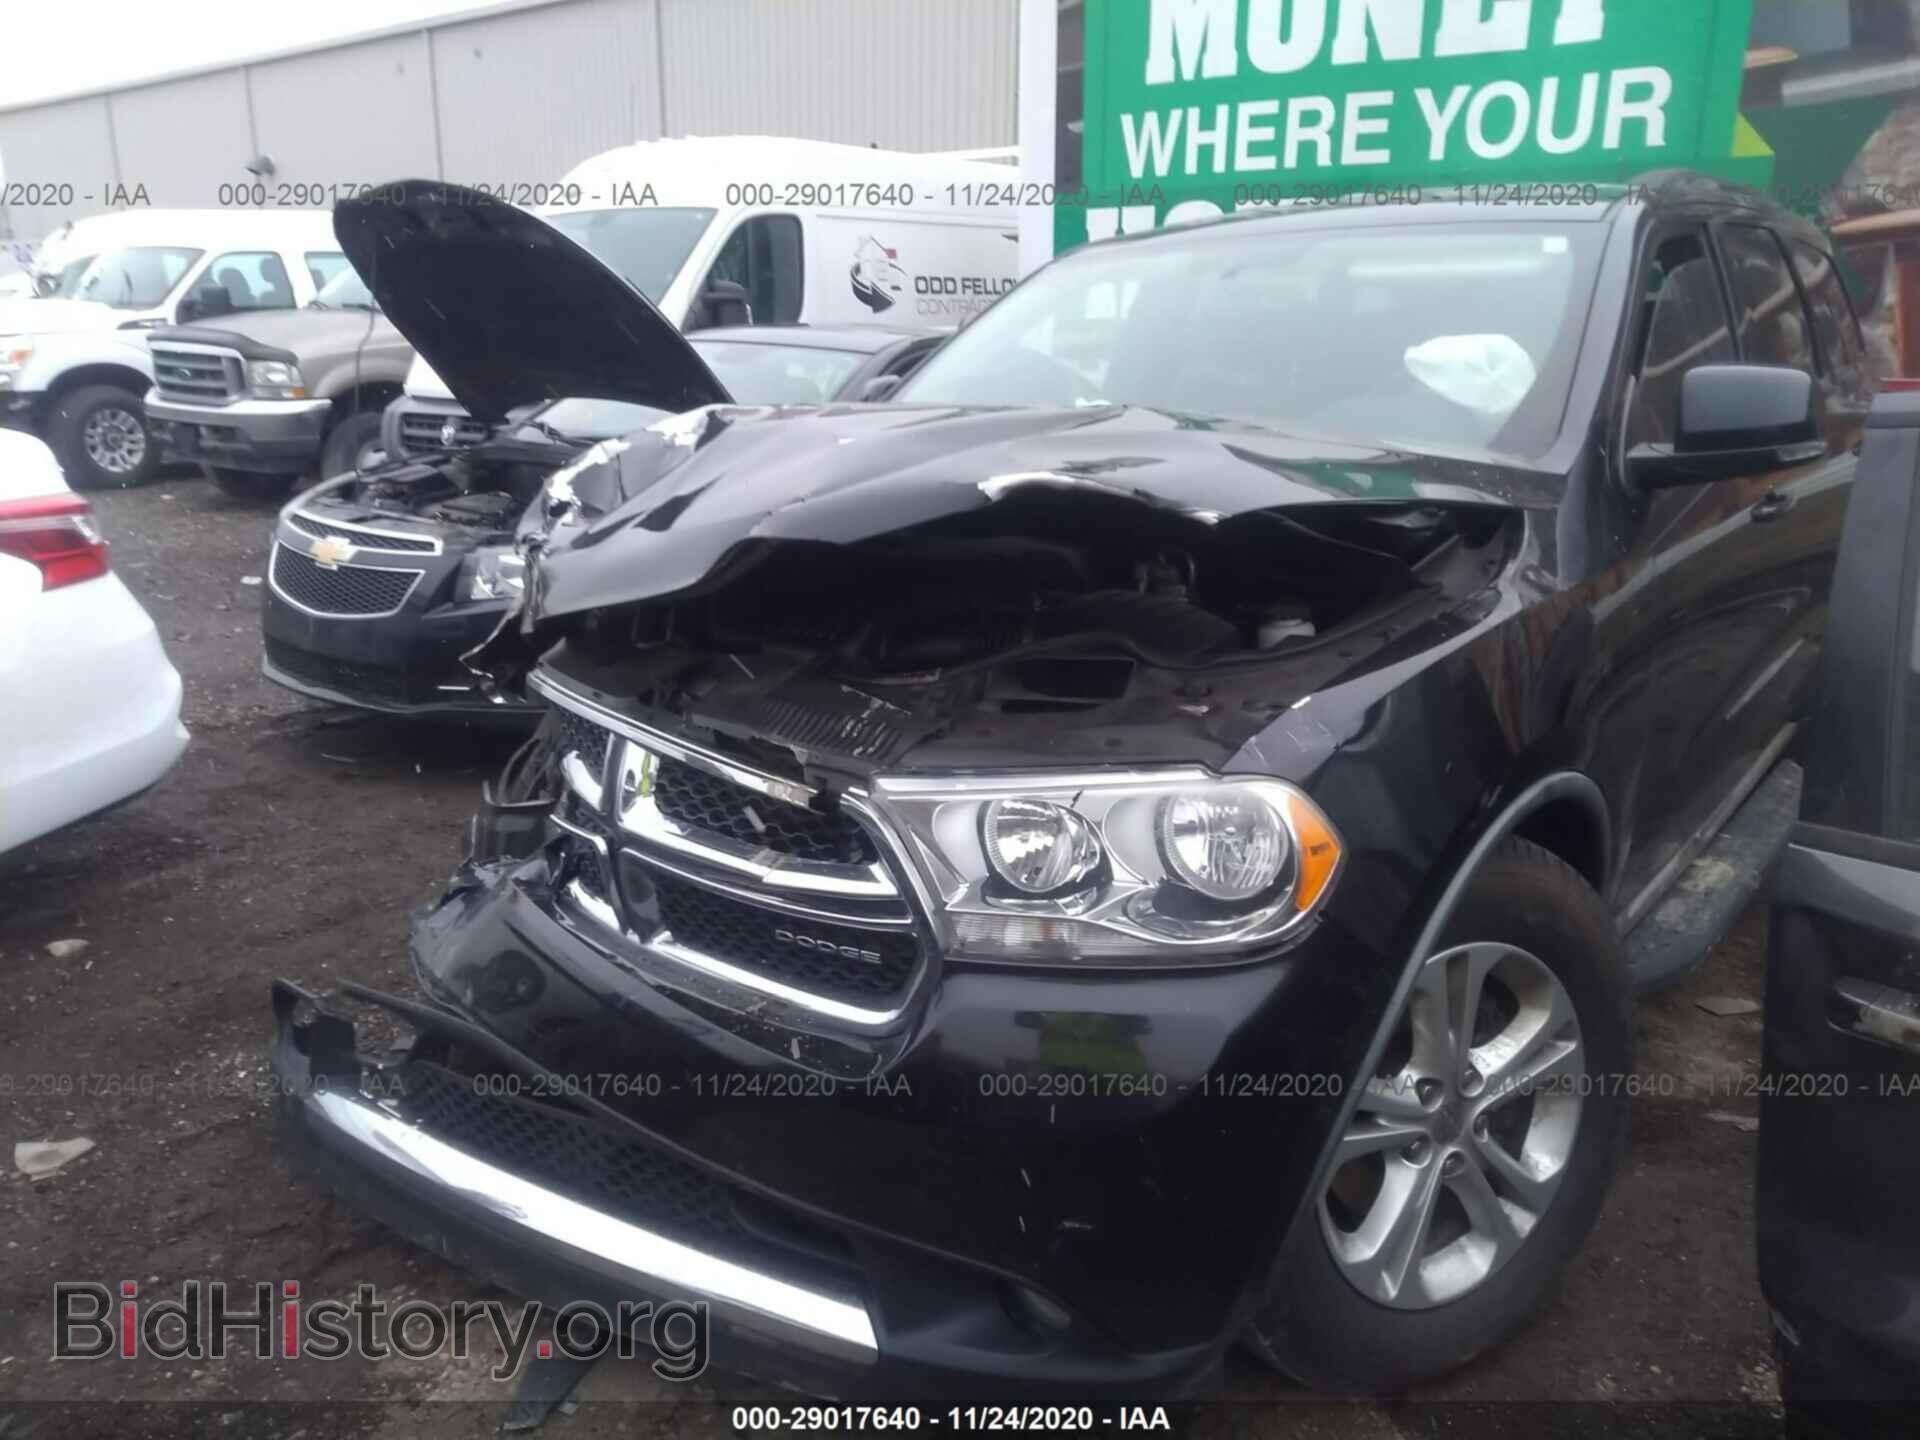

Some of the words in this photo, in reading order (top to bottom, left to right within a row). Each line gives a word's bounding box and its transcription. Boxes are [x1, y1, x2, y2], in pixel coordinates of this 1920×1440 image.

[1120, 90, 1394, 179] WHERE
[1414, 66, 1672, 161] YOUR
[914, 276, 958, 295] ODD
[962, 277, 1017, 295] FELLO
[775, 929, 881, 963] DODGE
